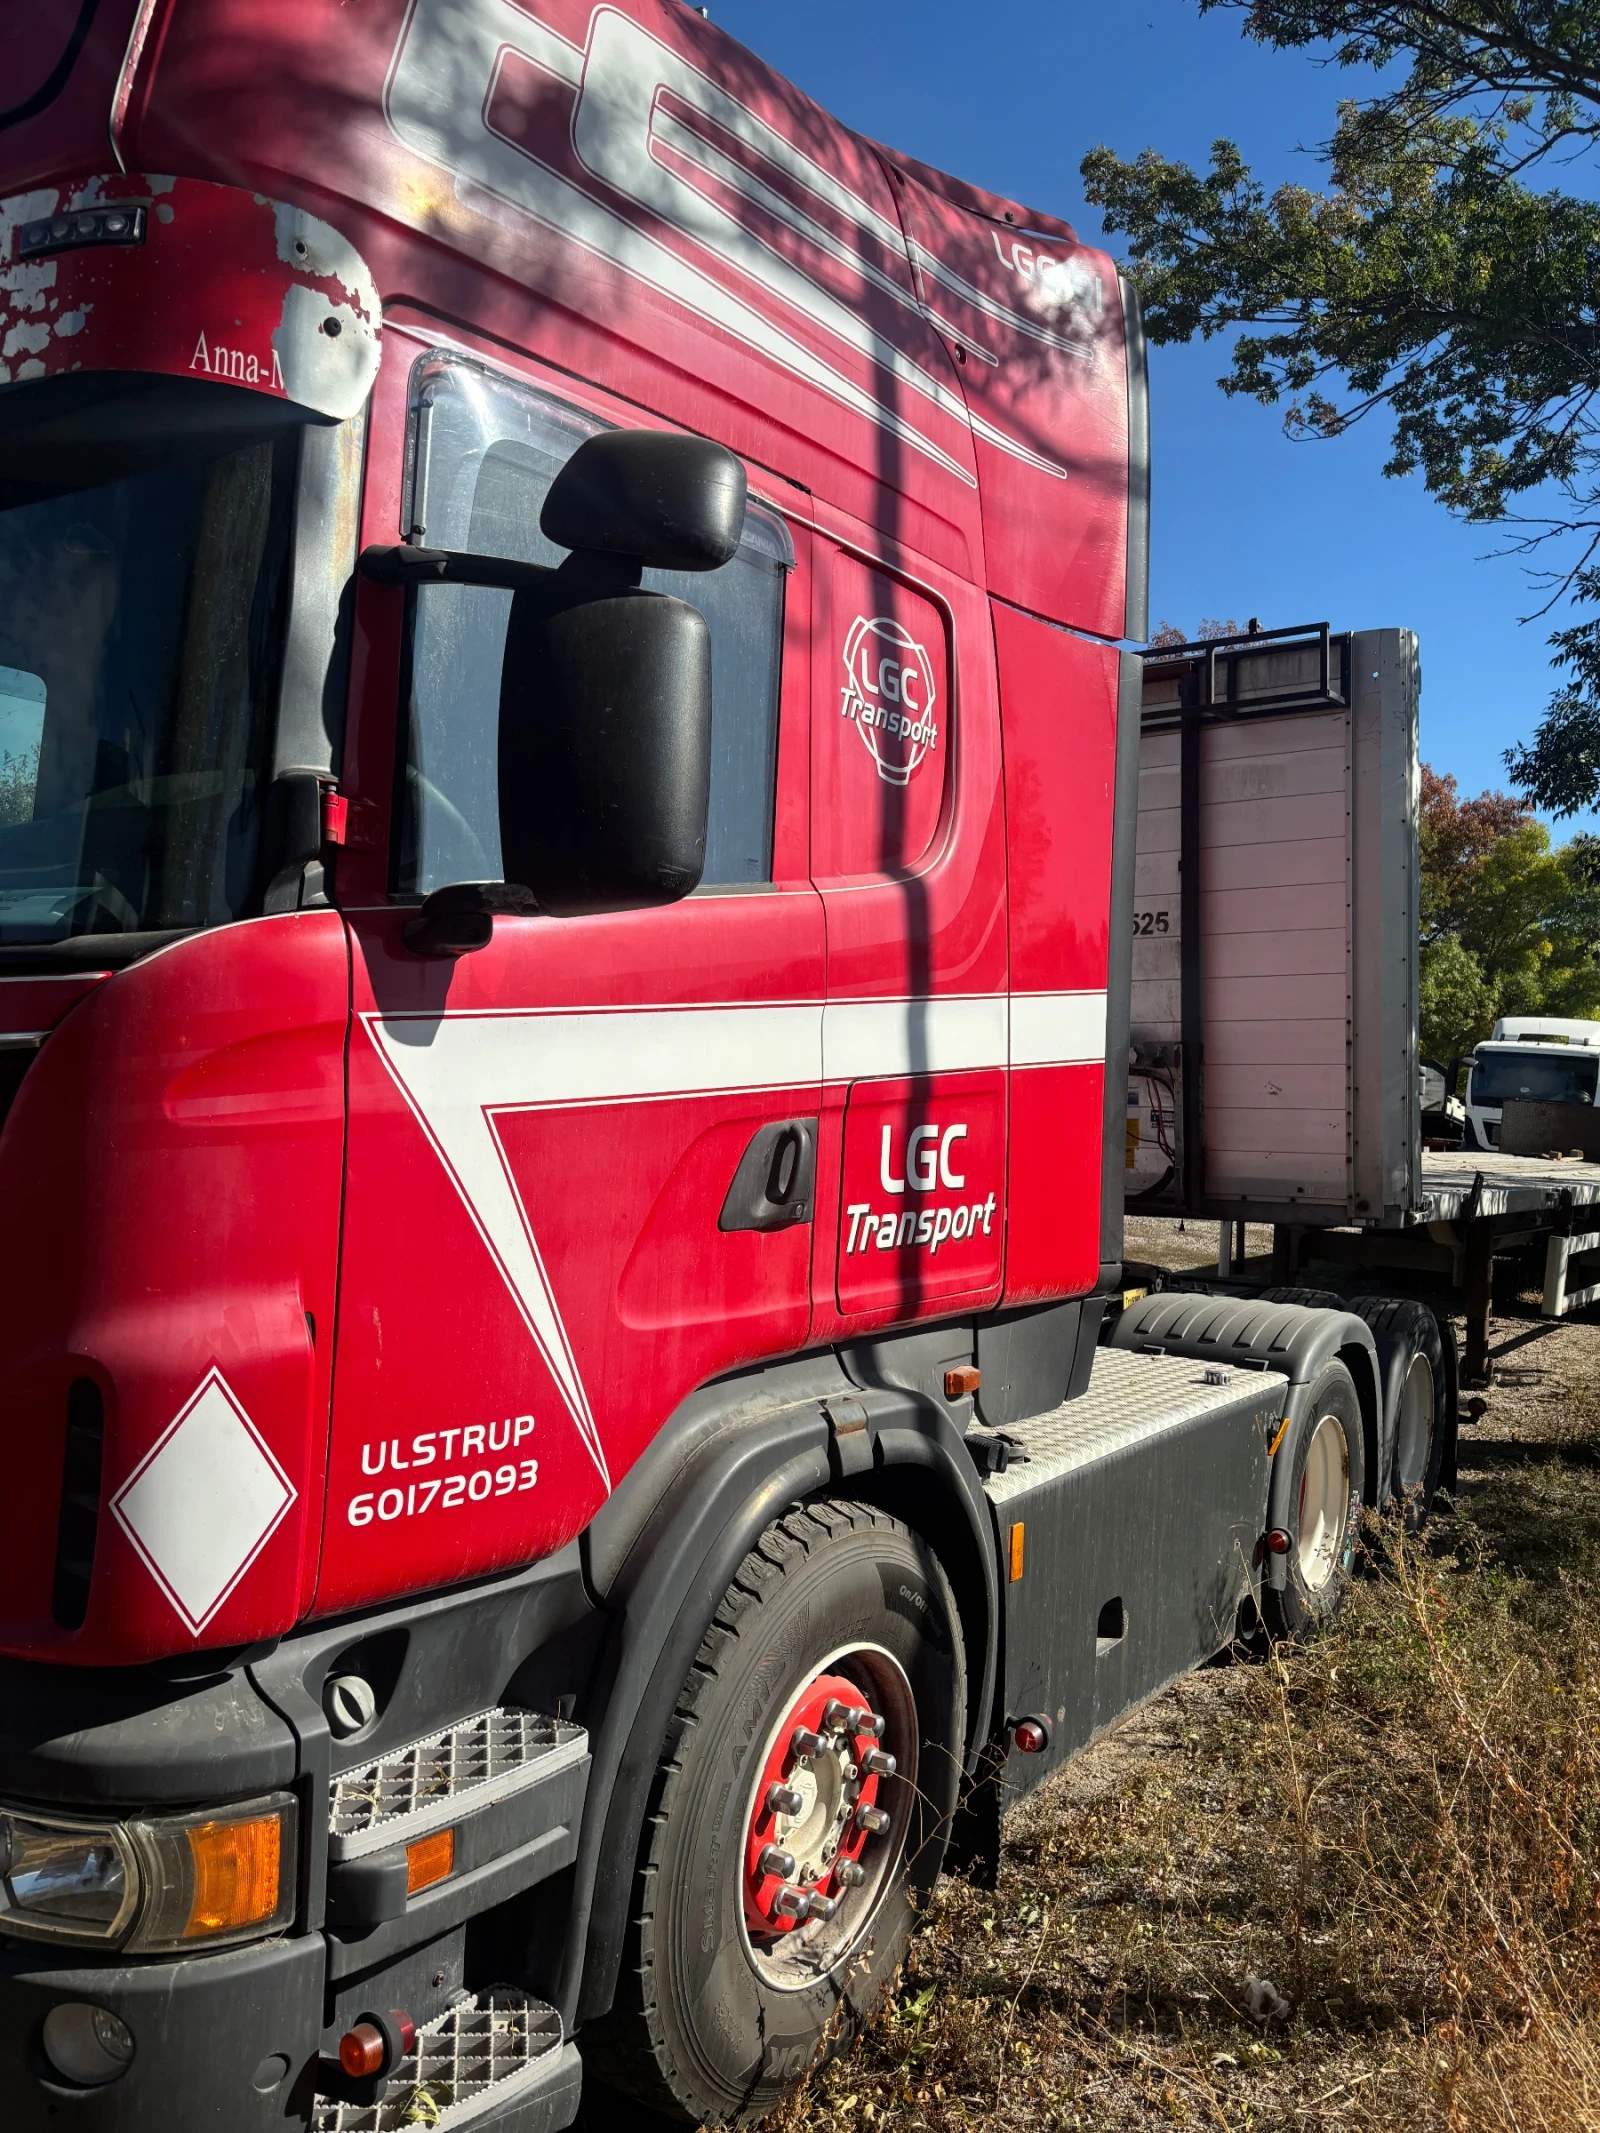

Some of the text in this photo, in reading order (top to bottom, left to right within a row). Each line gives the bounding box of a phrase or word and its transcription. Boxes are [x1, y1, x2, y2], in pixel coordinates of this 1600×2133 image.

[861, 647, 919, 712] LGC
[841, 687, 938, 750] Transport
[880, 1124, 967, 1194] LGC
[846, 1192, 997, 1254] Transport
[361, 1415, 535, 1475] ULSTRUP
[347, 1459, 539, 1527] 60172093
